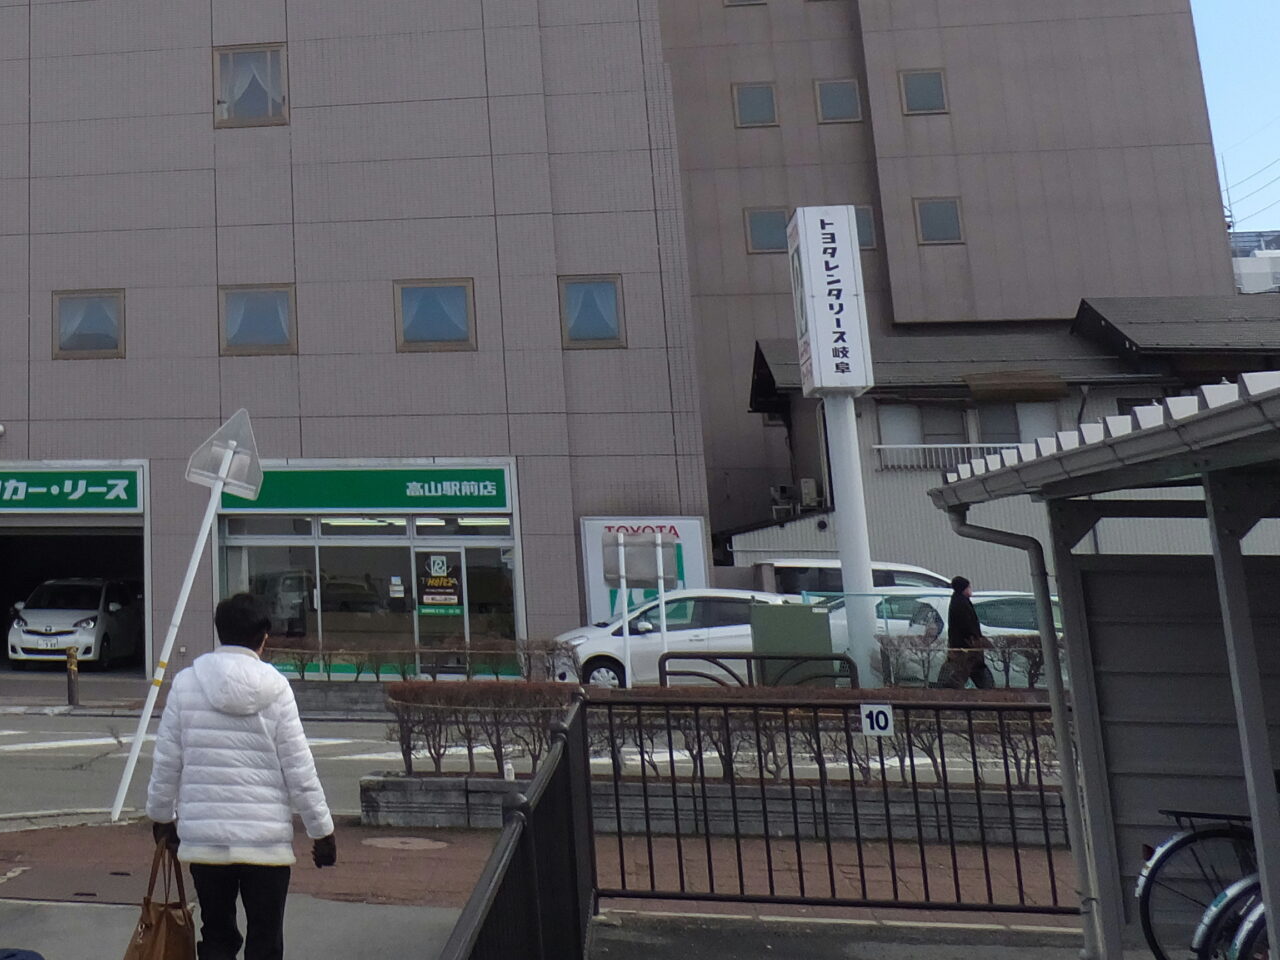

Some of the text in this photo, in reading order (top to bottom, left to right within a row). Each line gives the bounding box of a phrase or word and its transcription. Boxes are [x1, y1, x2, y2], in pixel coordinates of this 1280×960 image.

[820, 219, 851, 374] トヨタレンタリース岐阜
[405, 481, 497, 496] 高山駅前店
[865, 710, 889, 731] 10
